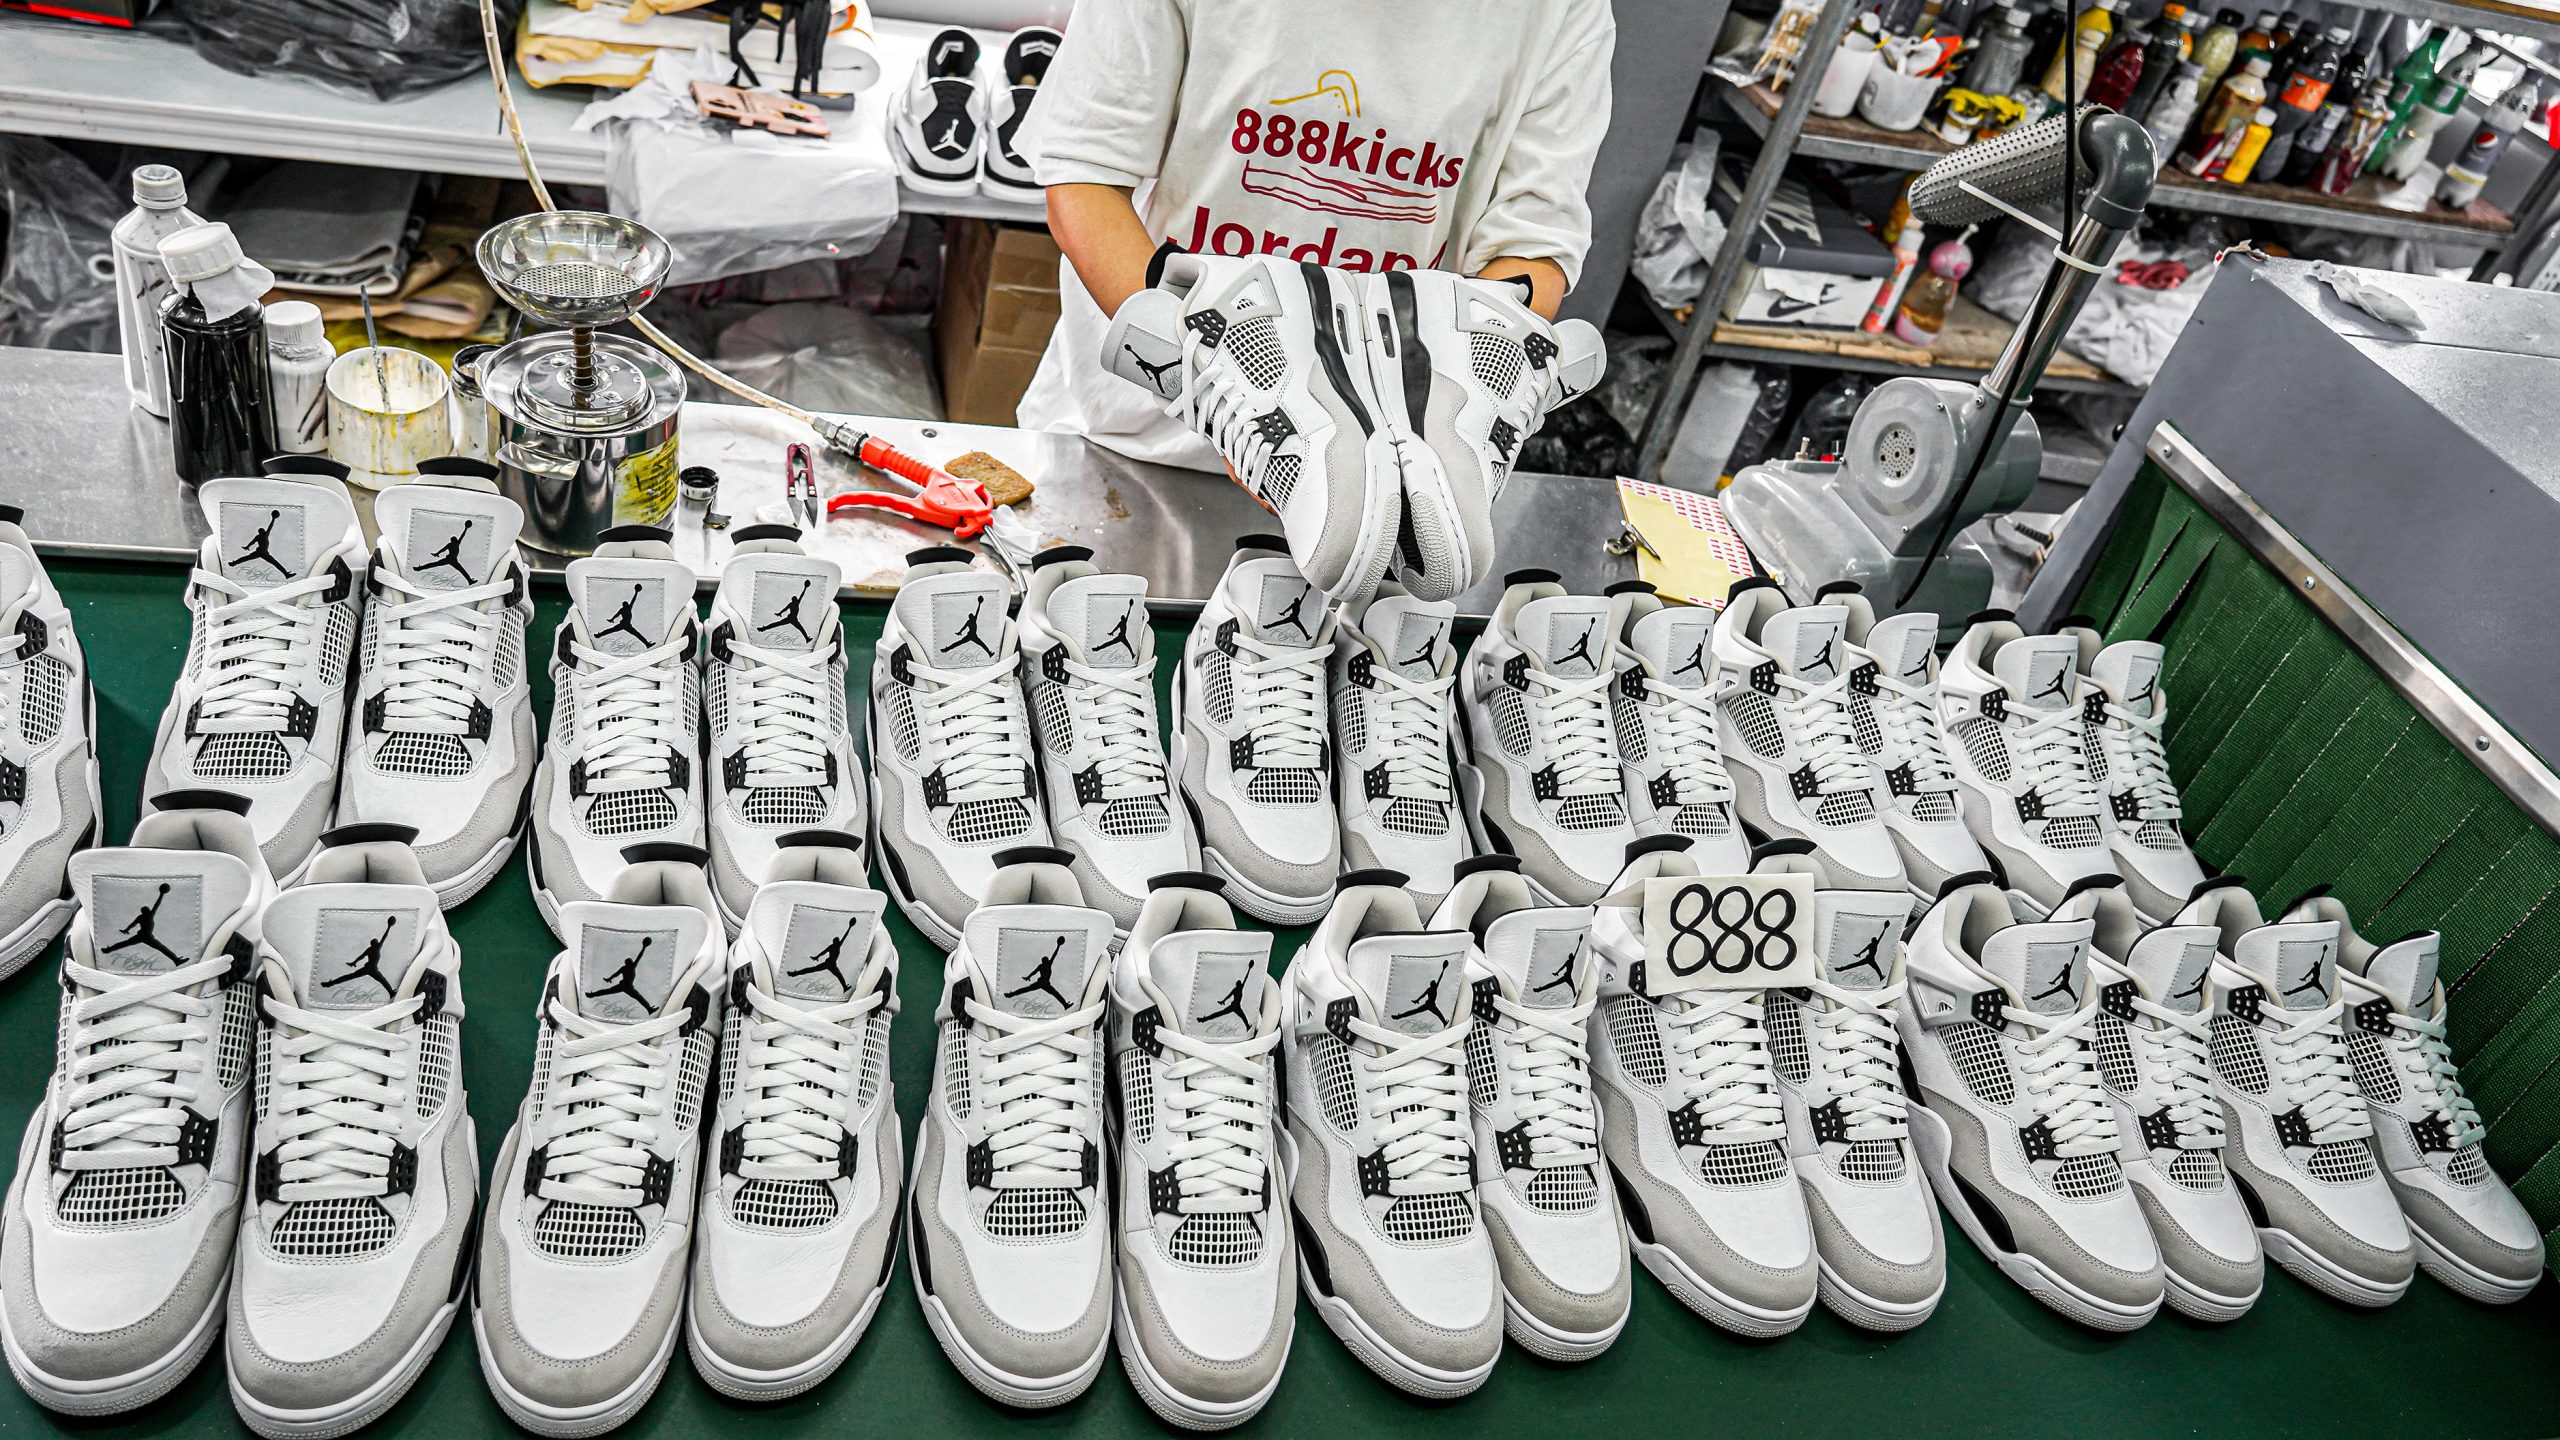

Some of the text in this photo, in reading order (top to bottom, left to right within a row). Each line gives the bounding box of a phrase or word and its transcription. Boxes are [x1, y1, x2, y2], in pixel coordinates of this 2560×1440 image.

[1231, 107, 1464, 188] 888kicks
[236, 566, 281, 581] Flight
[421, 571, 466, 587] Flight
[601, 637, 640, 652] Flight
[1666, 883, 1798, 977] 888
[110, 953, 166, 970] Flight
[332, 986, 382, 1003] Flight
[796, 977, 837, 996] Flight
[593, 1000, 640, 1018] Flight
[1013, 998, 1055, 1014] Flight
